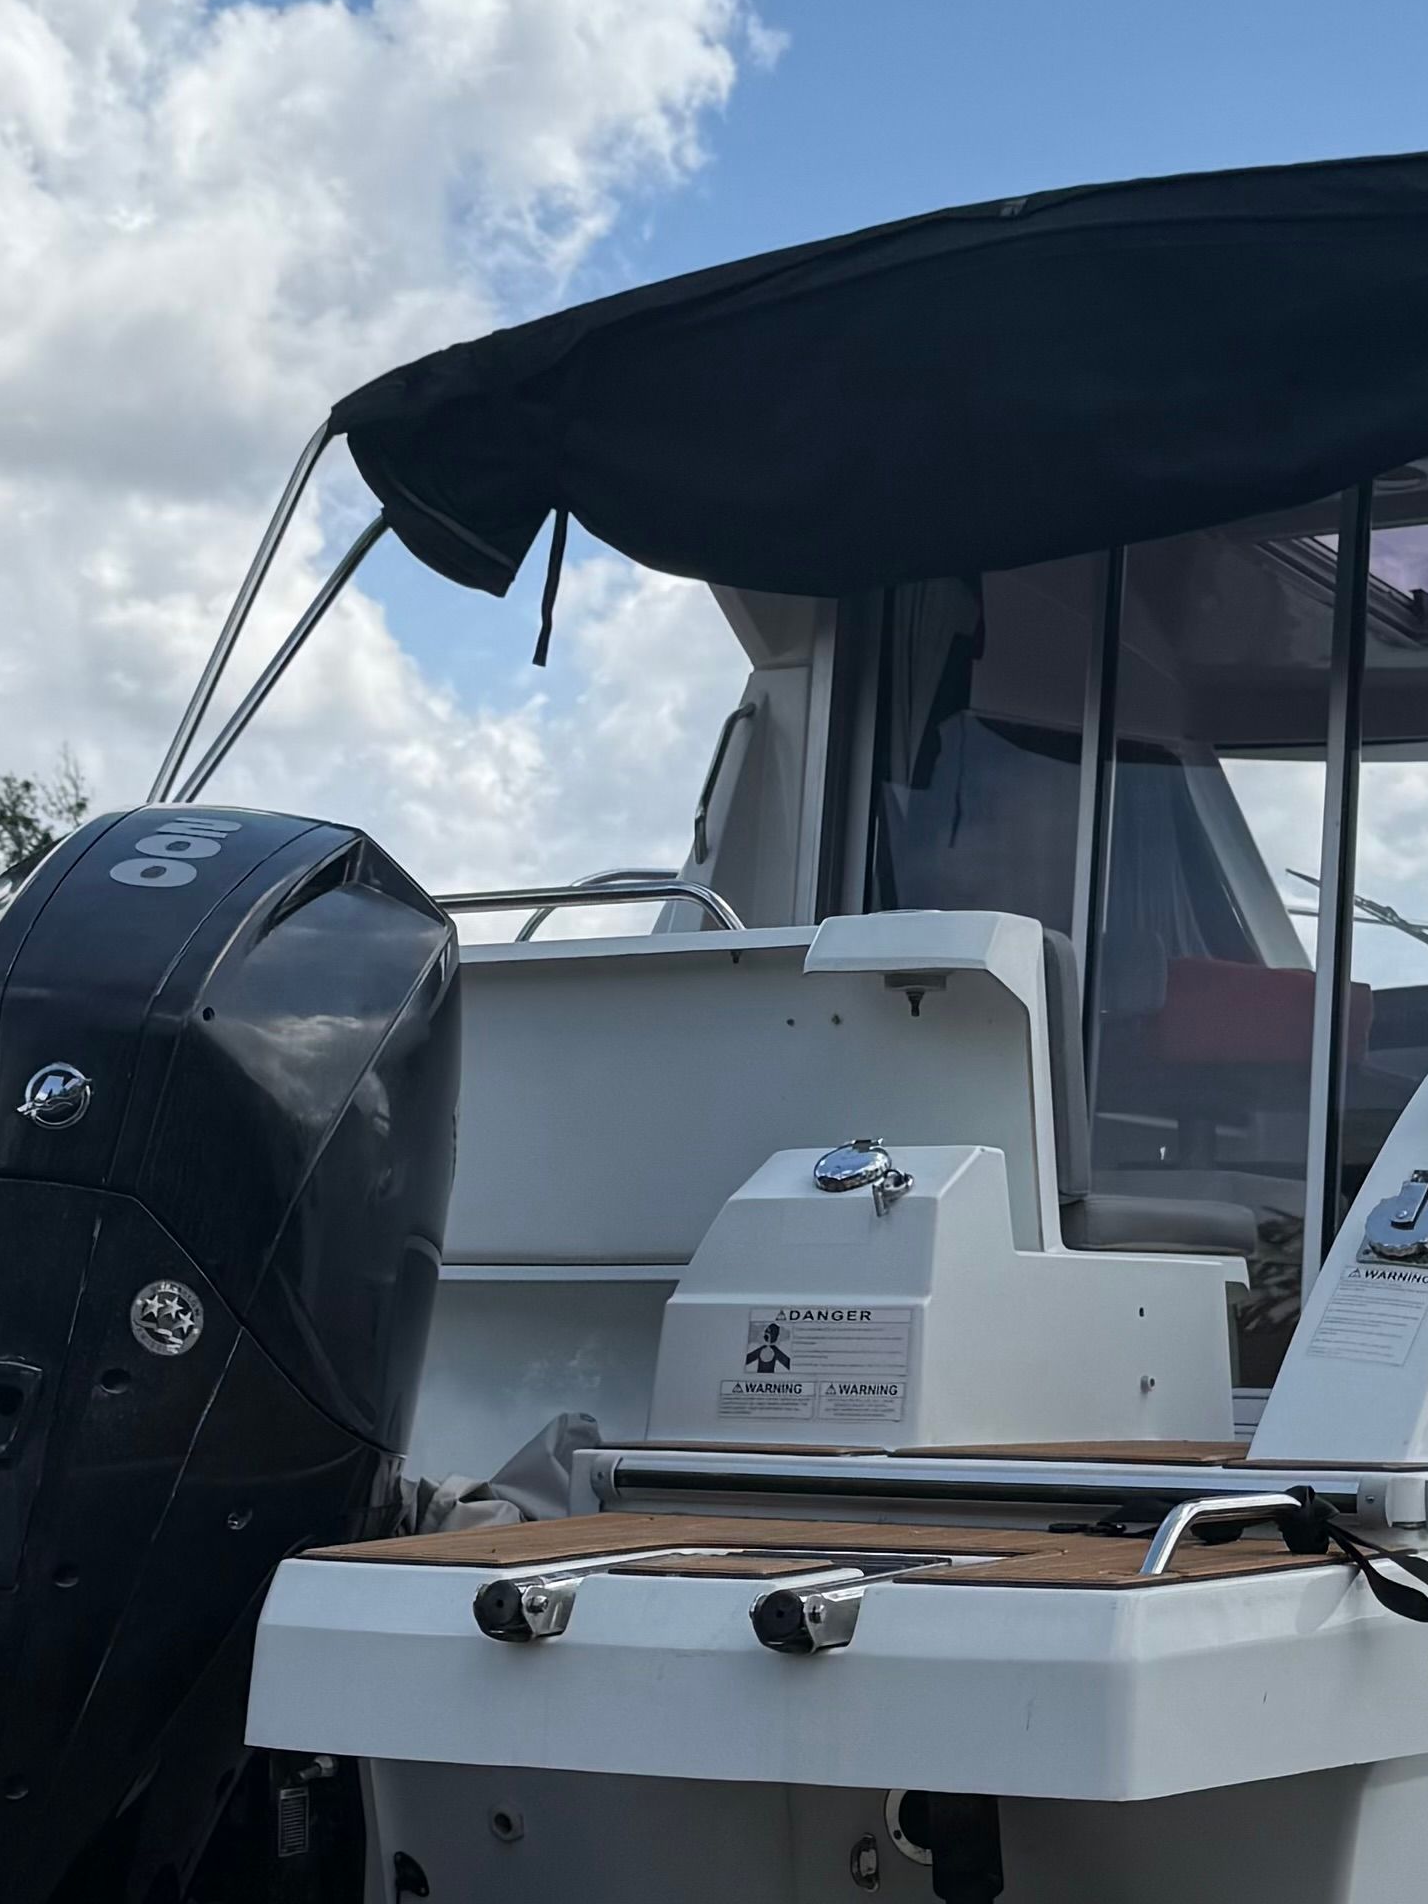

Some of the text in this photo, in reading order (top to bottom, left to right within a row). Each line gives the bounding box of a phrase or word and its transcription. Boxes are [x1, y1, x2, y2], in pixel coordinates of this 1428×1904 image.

[109, 816, 243, 888] 200
[789, 1309, 872, 1322] DANGER
[744, 1382, 803, 1395] WARNING
[838, 1383, 898, 1396] WARNING
